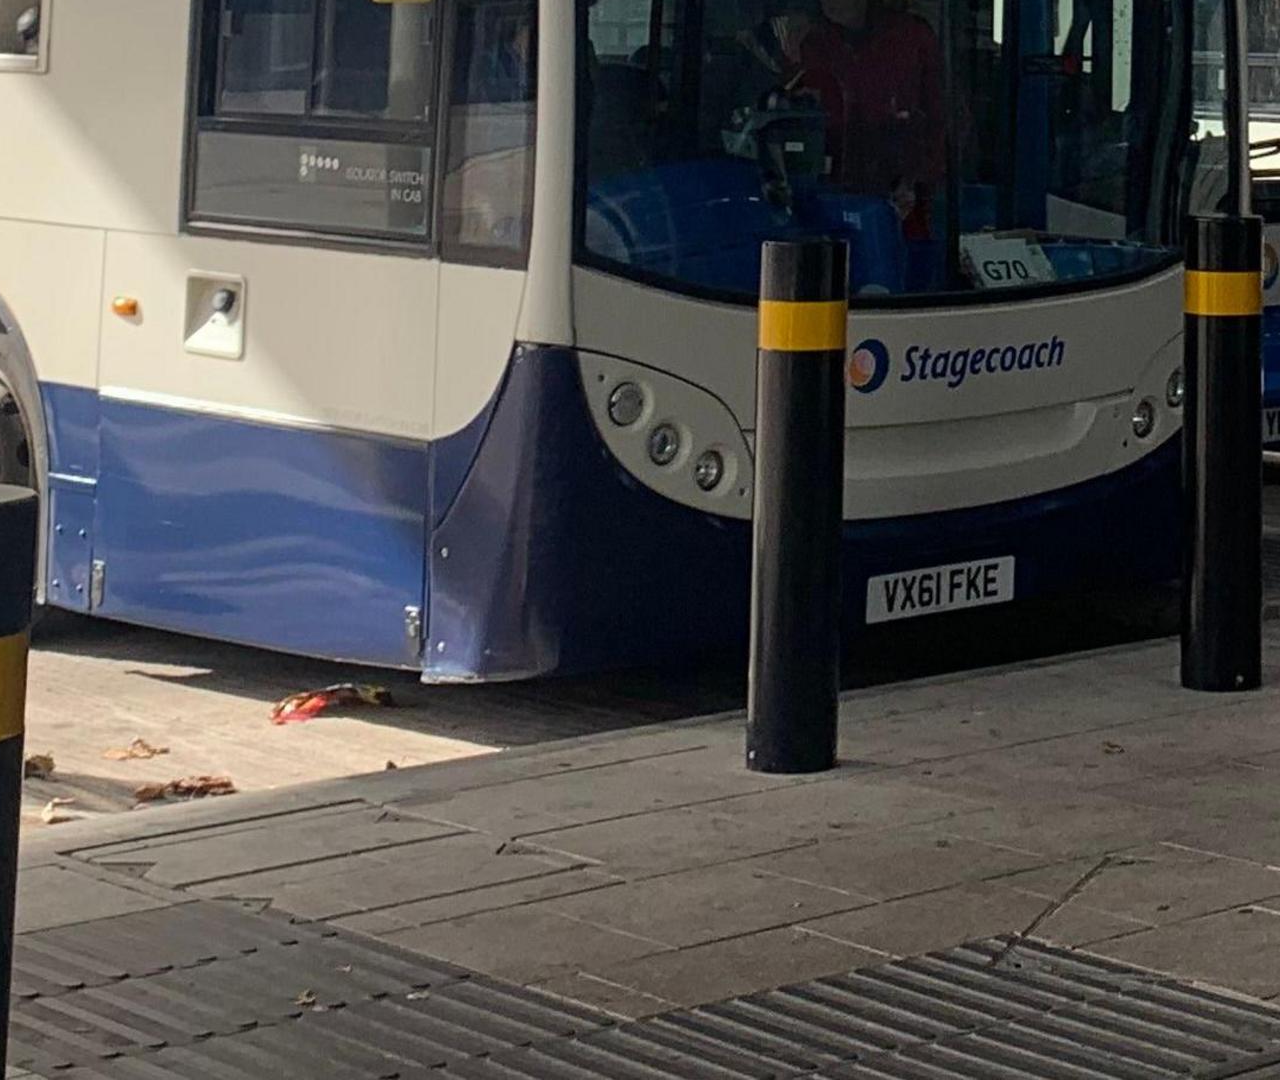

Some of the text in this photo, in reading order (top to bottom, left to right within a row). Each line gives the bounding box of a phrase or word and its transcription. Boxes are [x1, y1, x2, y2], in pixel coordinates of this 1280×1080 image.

[388, 170, 424, 185] SWITCH
[390, 188, 422, 203] IN CAB
[983, 260, 1030, 281] G70
[900, 335, 1066, 389] Stagecoach
[884, 562, 1000, 613] VX61 FKE
